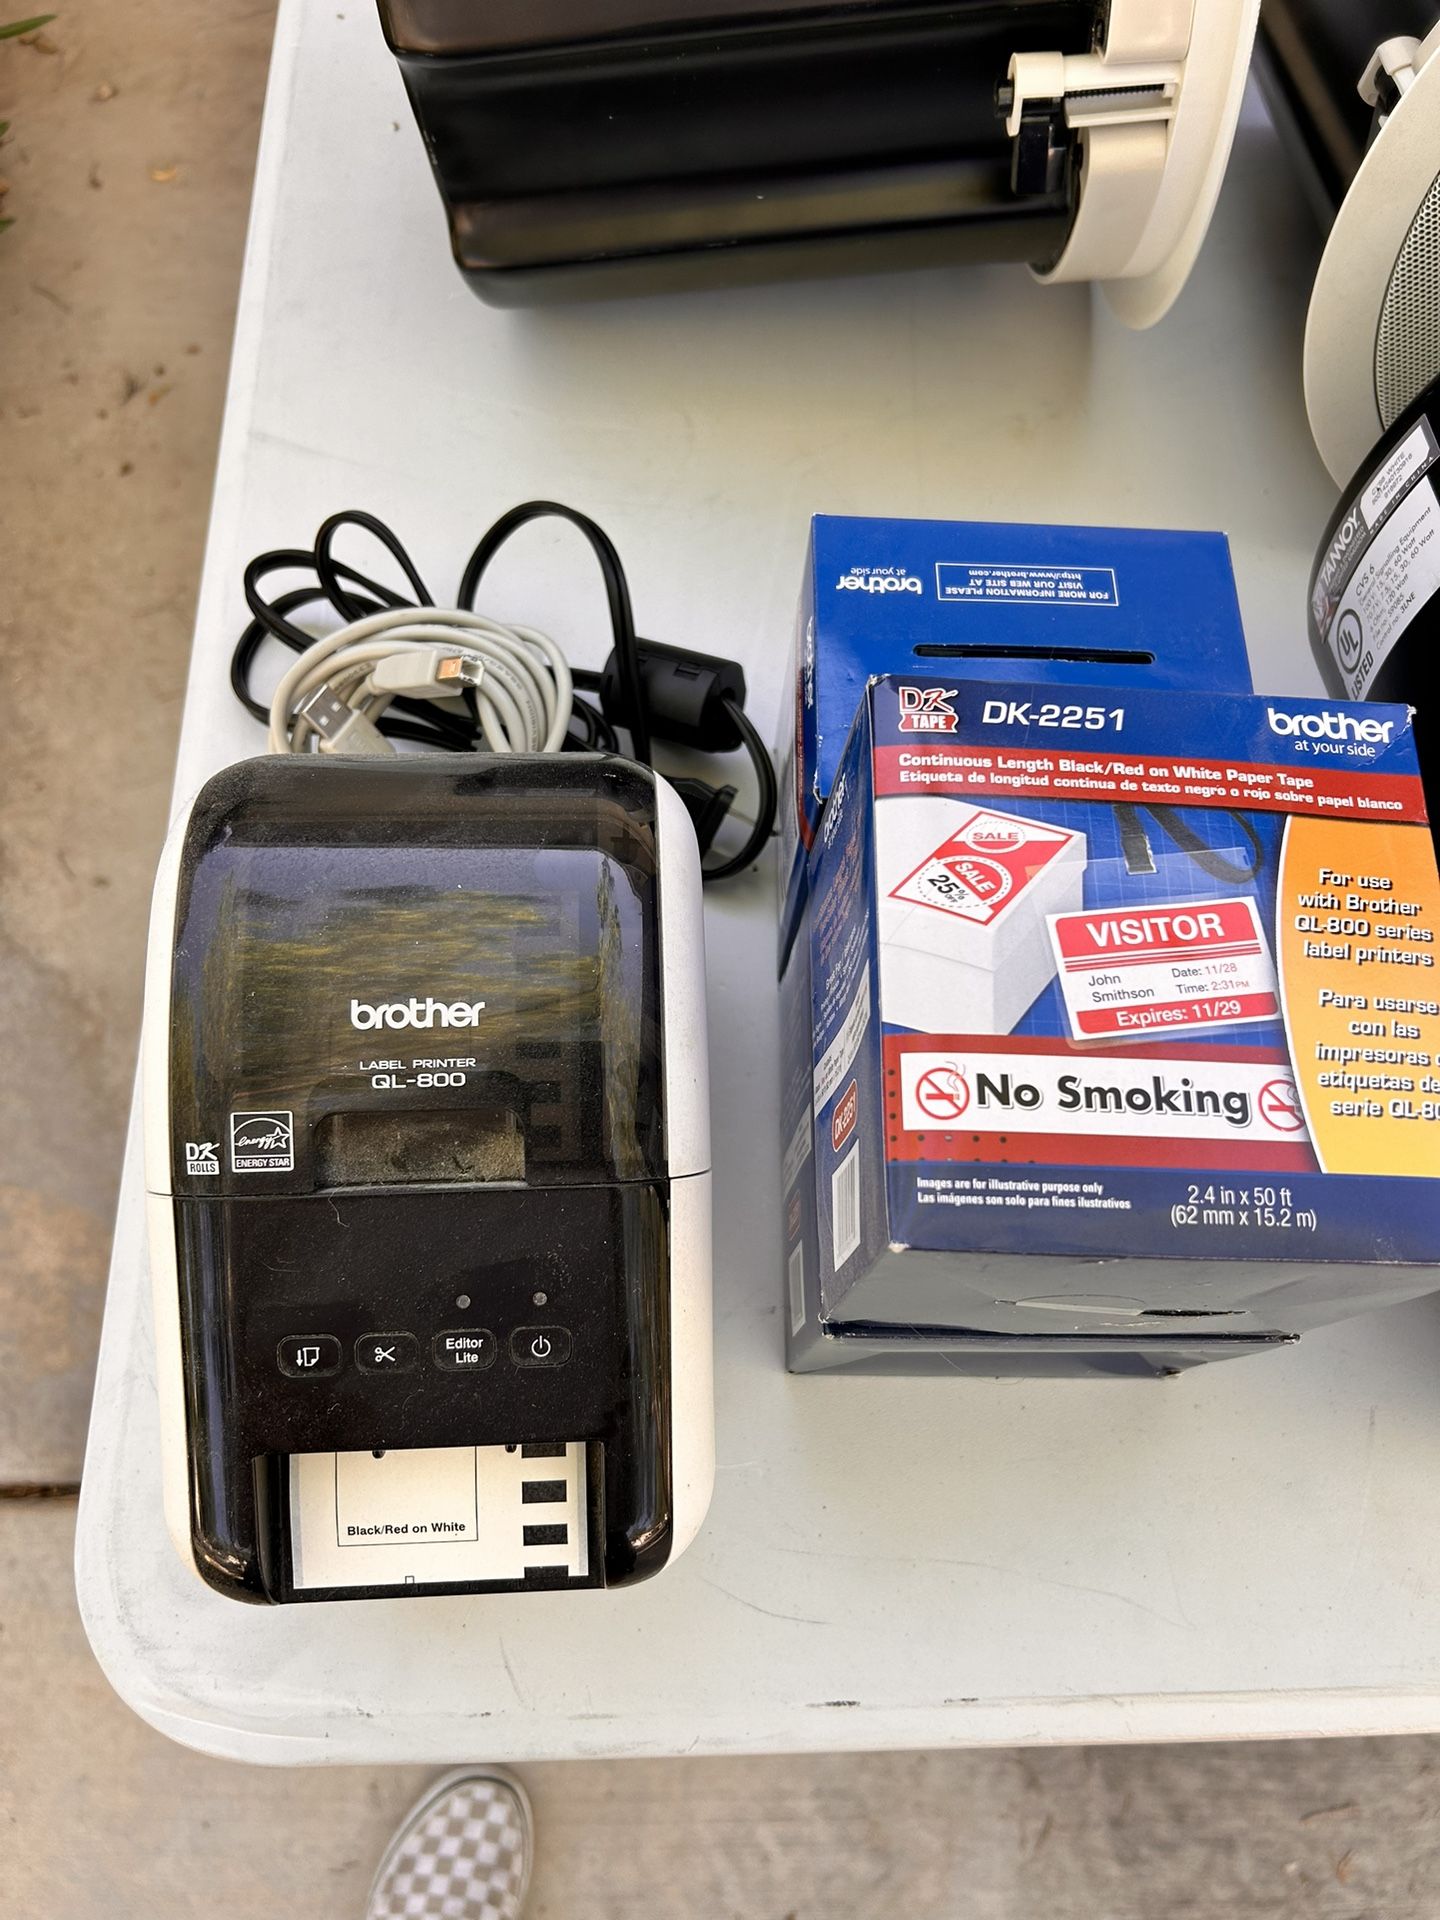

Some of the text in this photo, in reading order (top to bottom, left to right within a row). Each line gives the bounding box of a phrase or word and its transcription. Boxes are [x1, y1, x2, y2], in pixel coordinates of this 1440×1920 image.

[1369, 456, 1433, 535] MADE IN CHINA
[1398, 507, 1431, 546] Equipment
[1321, 507, 1358, 587] TANNOY
[1401, 534, 1416, 557] Watt
[1418, 526, 1435, 550] Watt
[850, 567, 906, 576] at your side
[968, 569, 1082, 580] http://www.brother.com
[1354, 562, 1375, 597] CVS 6
[1394, 571, 1409, 593] Watt
[836, 575, 922, 594] brother
[945, 586, 1109, 600] FOR MORE INFORMATION PLEASE
[969, 578, 1084, 590] VISIT OUR WEB SITE AT
[1340, 629, 1359, 656] UL
[1351, 650, 1374, 701] LISTED
[899, 687, 958, 713] DK
[911, 714, 947, 730] TAPE
[982, 700, 1125, 731] DK-2251
[1267, 707, 1394, 744] brother
[1294, 740, 1376, 757] at your side
[898, 752, 1314, 790] Continuous Length Black/Red on White Paper Tape
[900, 770, 1403, 810] Etiqueta de longitud continua de texto negro o rojo sobre papel blanco
[972, 832, 1019, 840] SALE
[954, 862, 997, 894] SALE
[1319, 868, 1392, 890] For use
[944, 893, 958, 903] OFF
[1298, 892, 1421, 916] with Brother
[1085, 913, 1225, 948] VISITOR
[1294, 915, 1434, 942] QL-800 series
[1304, 940, 1434, 966] label printers
[1088, 974, 1122, 987] John
[1172, 962, 1238, 978] Date: 11/28
[1092, 987, 1155, 1004] Smithson
[1176, 983, 1210, 995] Time:
[1319, 989, 1440, 1014] Para usarse
[350, 998, 486, 1031] brother
[1116, 1000, 1242, 1028] Expires: 11/29
[1348, 1020, 1420, 1038] con las
[359, 1057, 477, 1070] LABEL PRINTER
[1315, 1041, 1431, 1066] impresoras
[371, 1072, 466, 1089] QL-800
[1318, 1070, 1414, 1093] etiquetas
[976, 1073, 1253, 1126] No Smoking
[1331, 1099, 1383, 1118] serie
[186, 1142, 220, 1160] DK
[190, 1162, 216, 1172] ROLLS
[236, 1158, 290, 1168] ENERGY STAR
[916, 1177, 1104, 1196] Images are for illustrative purpose only
[1188, 1185, 1292, 1207] 2.4 in x 50 ft
[918, 1192, 1132, 1210] Las imágenes son solo para fines ilustrativos
[1171, 1204, 1316, 1232] (62 mm x 15.2 m)
[446, 1336, 483, 1350] Editor
[456, 1351, 479, 1364] Lite
[347, 1522, 466, 1536] Black/Red on White
